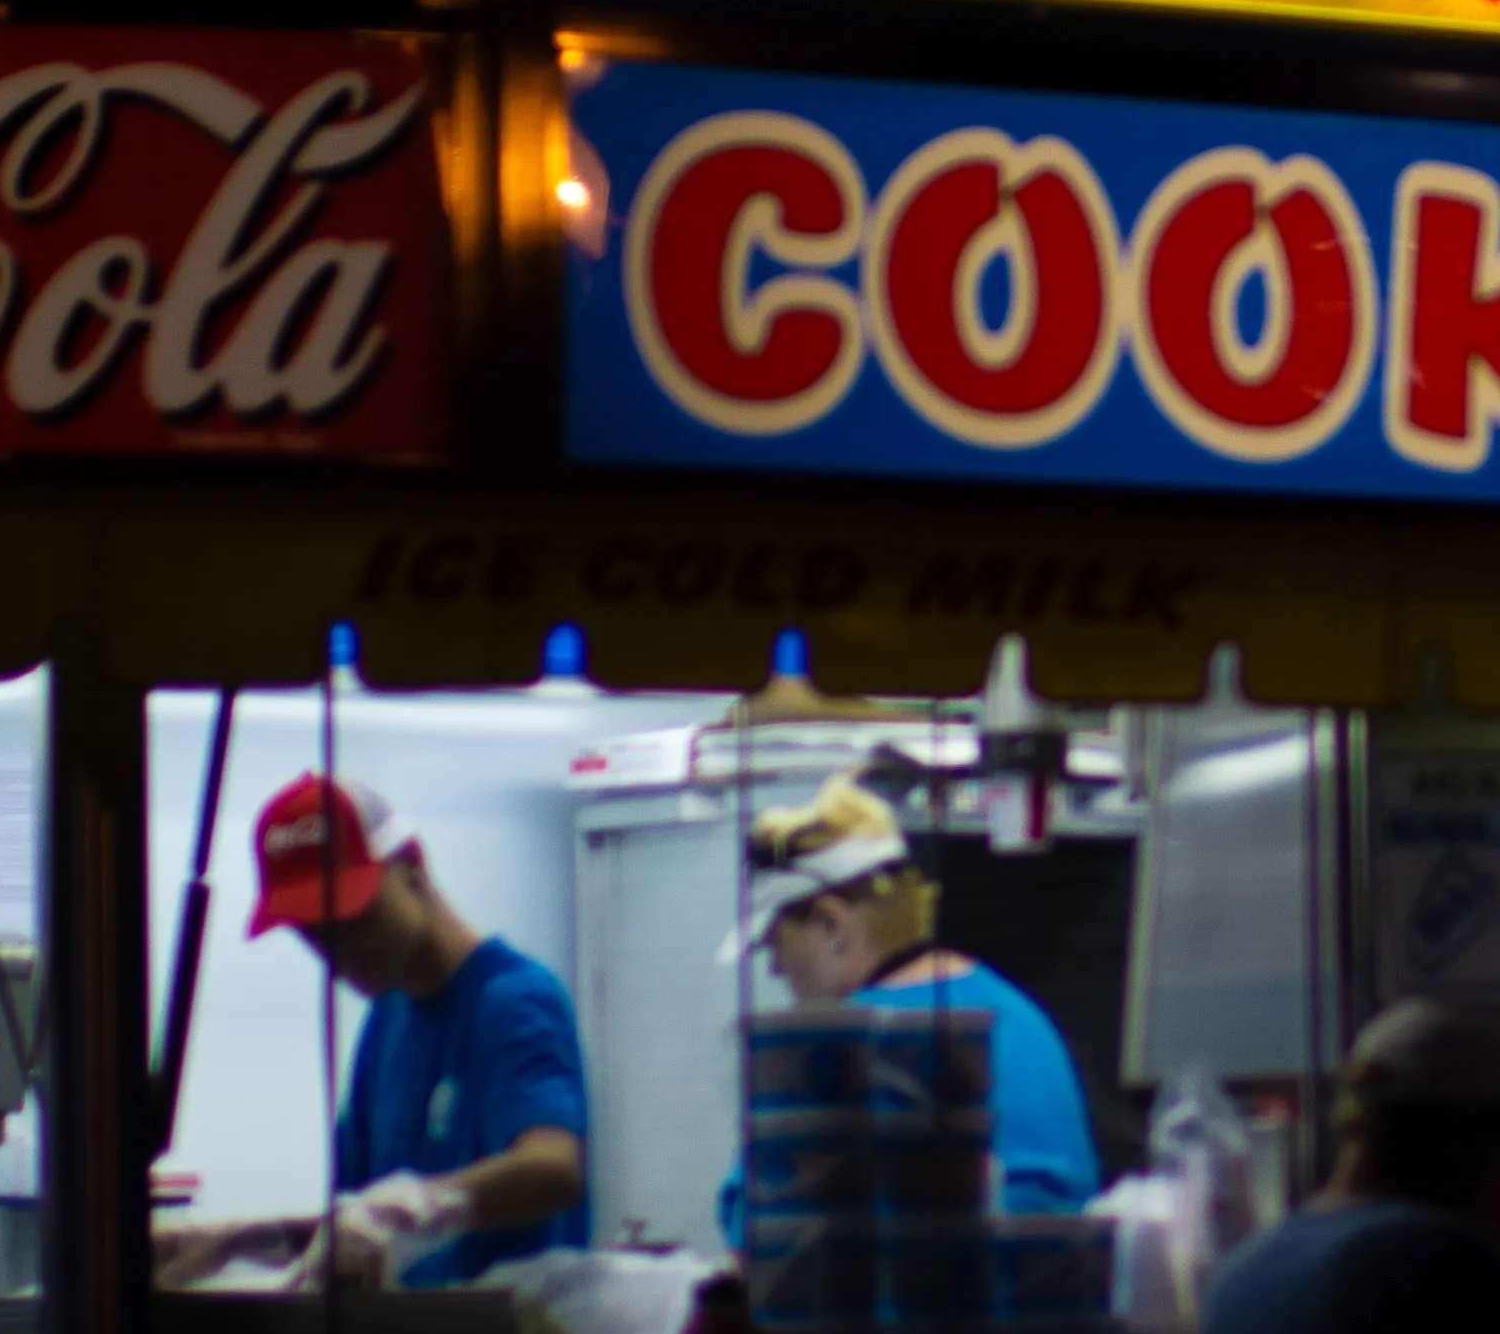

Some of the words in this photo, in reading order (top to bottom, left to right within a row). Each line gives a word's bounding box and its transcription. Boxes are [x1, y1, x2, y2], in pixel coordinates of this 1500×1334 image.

[362, 534, 540, 604] ICE
[587, 539, 865, 609] COLD
[910, 551, 1205, 627] MILK
